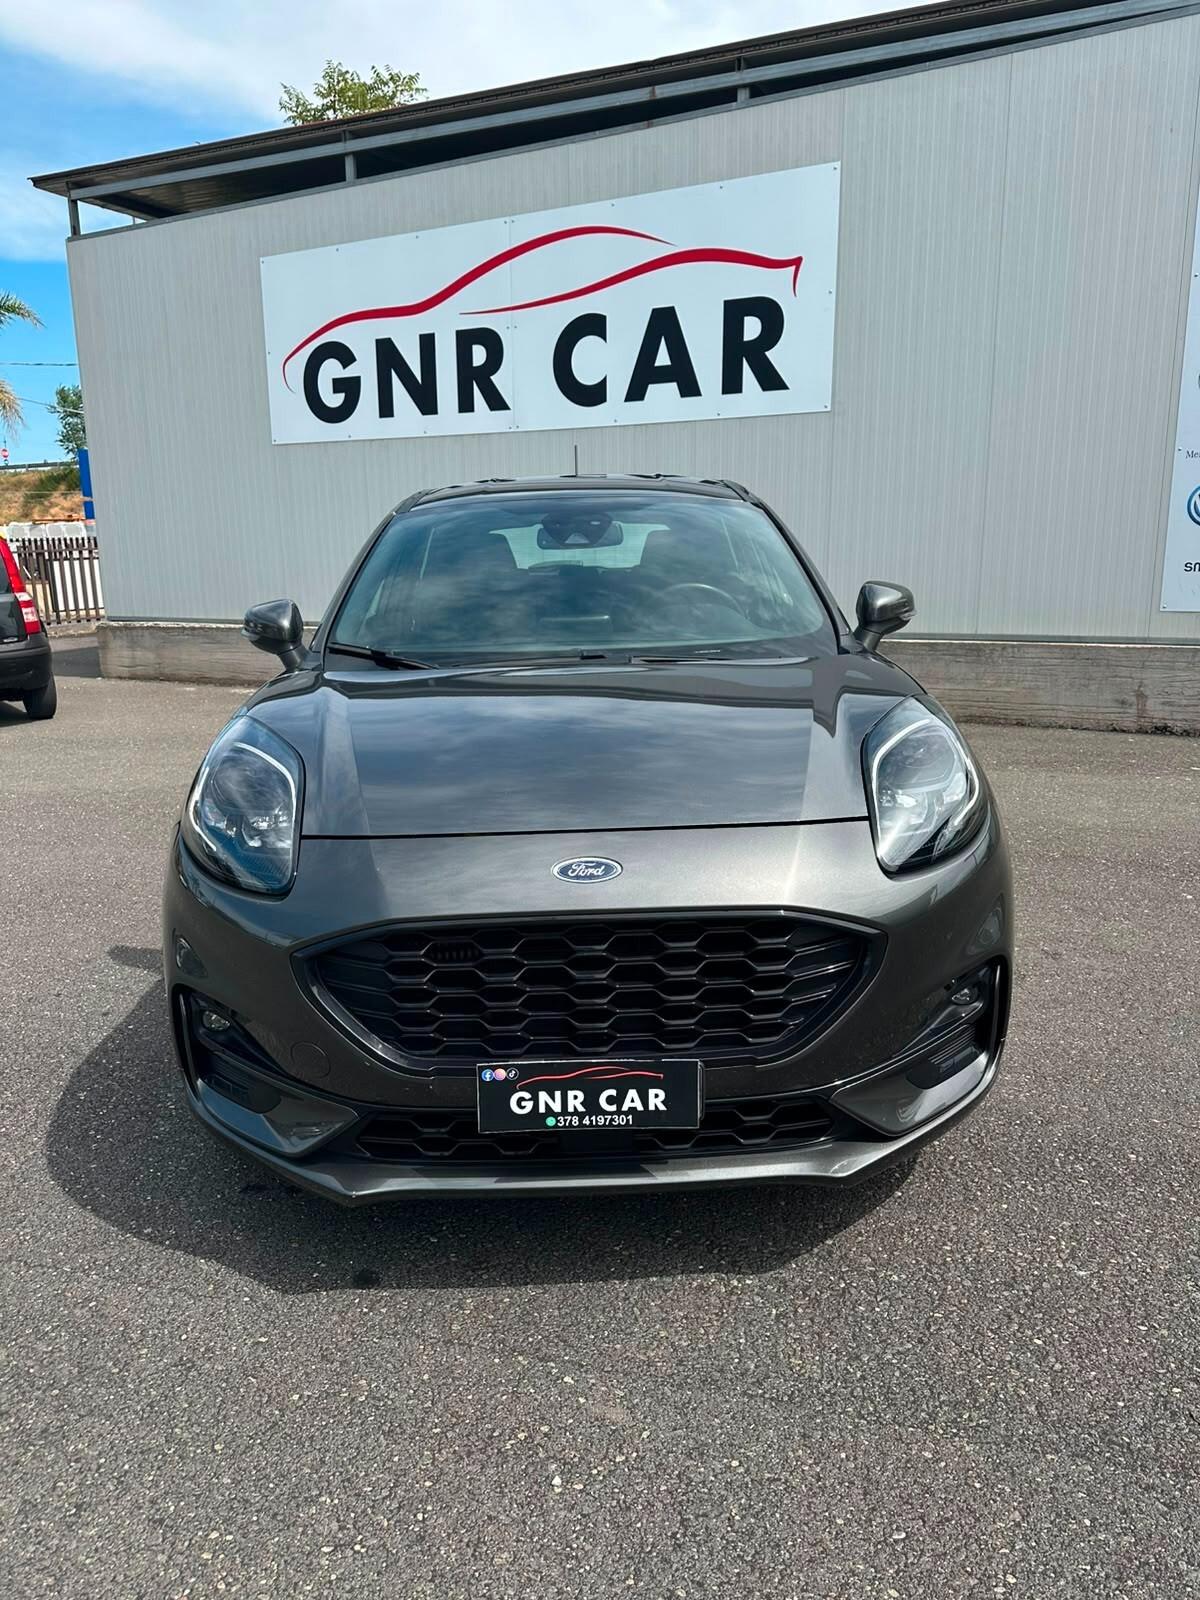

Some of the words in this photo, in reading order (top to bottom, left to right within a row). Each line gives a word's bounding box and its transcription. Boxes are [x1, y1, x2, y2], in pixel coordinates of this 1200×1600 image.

[303, 327, 511, 424] GNR
[552, 296, 790, 408] CAR
[567, 861, 606, 877] Ford
[509, 1089, 587, 1115] GNR
[598, 1088, 668, 1112] CAR
[556, 1115, 579, 1127] 378
[582, 1114, 634, 1126] 4197301
